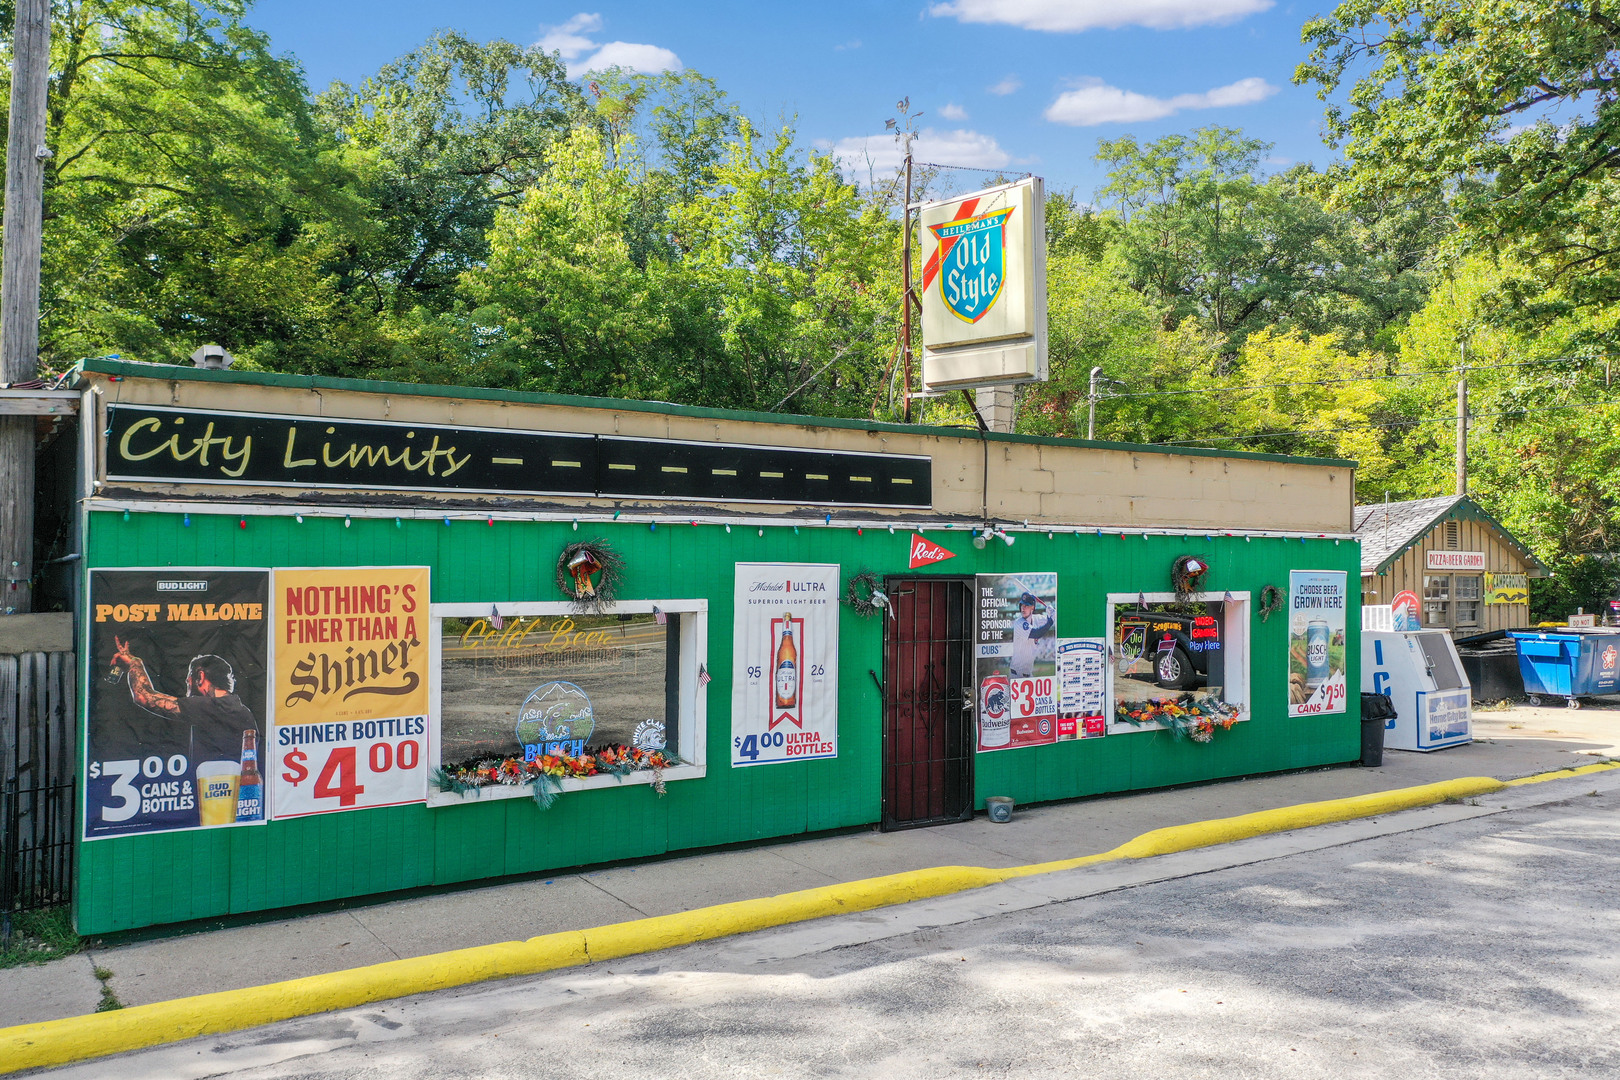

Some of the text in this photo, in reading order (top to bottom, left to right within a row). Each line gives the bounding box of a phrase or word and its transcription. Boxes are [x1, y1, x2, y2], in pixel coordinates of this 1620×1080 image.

[942, 217, 999, 236] HEILEMAN'S
[956, 232, 990, 270] Old
[947, 267, 998, 313] Style
[119, 416, 472, 478] City Limits
[912, 542, 945, 560] Red's
[1429, 554, 1446, 565] PIZZA
[1449, 554, 1462, 565] BEER
[1464, 555, 1483, 566] GARDEN
[158, 582, 206, 590] BUD LIGHT
[749, 582, 825, 592] Michelob ULTRA
[981, 588, 993, 596] THE
[1300, 585, 1338, 594] CHOOSE BEER
[286, 584, 416, 616] NOTHING'S
[981, 599, 1008, 608] OFFICIAL
[1294, 596, 1342, 608] GROWN HERE
[95, 603, 262, 622] POST MALONE
[981, 610, 998, 618] BEER
[981, 620, 1011, 630] SPONSOR
[1153, 622, 1182, 632] Seagram's
[1194, 616, 1214, 626] VIDEO
[286, 616, 417, 644] FINER THAN A
[462, 618, 612, 651] Cold Beer
[981, 631, 1003, 640] OF THE
[1130, 632, 1142, 644] Old
[981, 646, 999, 655] CUBS
[1123, 643, 1141, 660] Style
[1189, 641, 1220, 652] Play Here
[1307, 644, 1328, 656] BUSCH
[285, 638, 421, 708] Shiner
[747, 664, 824, 678] 95 2.6
[1035, 697, 1048, 705] CANS
[1035, 705, 1055, 714] BOTTLES
[1297, 703, 1321, 714] CANS
[1430, 711, 1467, 724] Home City Ice
[279, 717, 424, 746] SHINER BOTTLES
[632, 718, 666, 745] WHITE CLAW
[786, 732, 820, 744] ULTRA
[786, 742, 833, 755] BOTTLES
[141, 780, 192, 797] CANS &
[209, 783, 229, 791] BUD
[205, 790, 232, 798] LIGHT
[142, 796, 194, 813] BOTTLES
[238, 800, 258, 808] BUD
